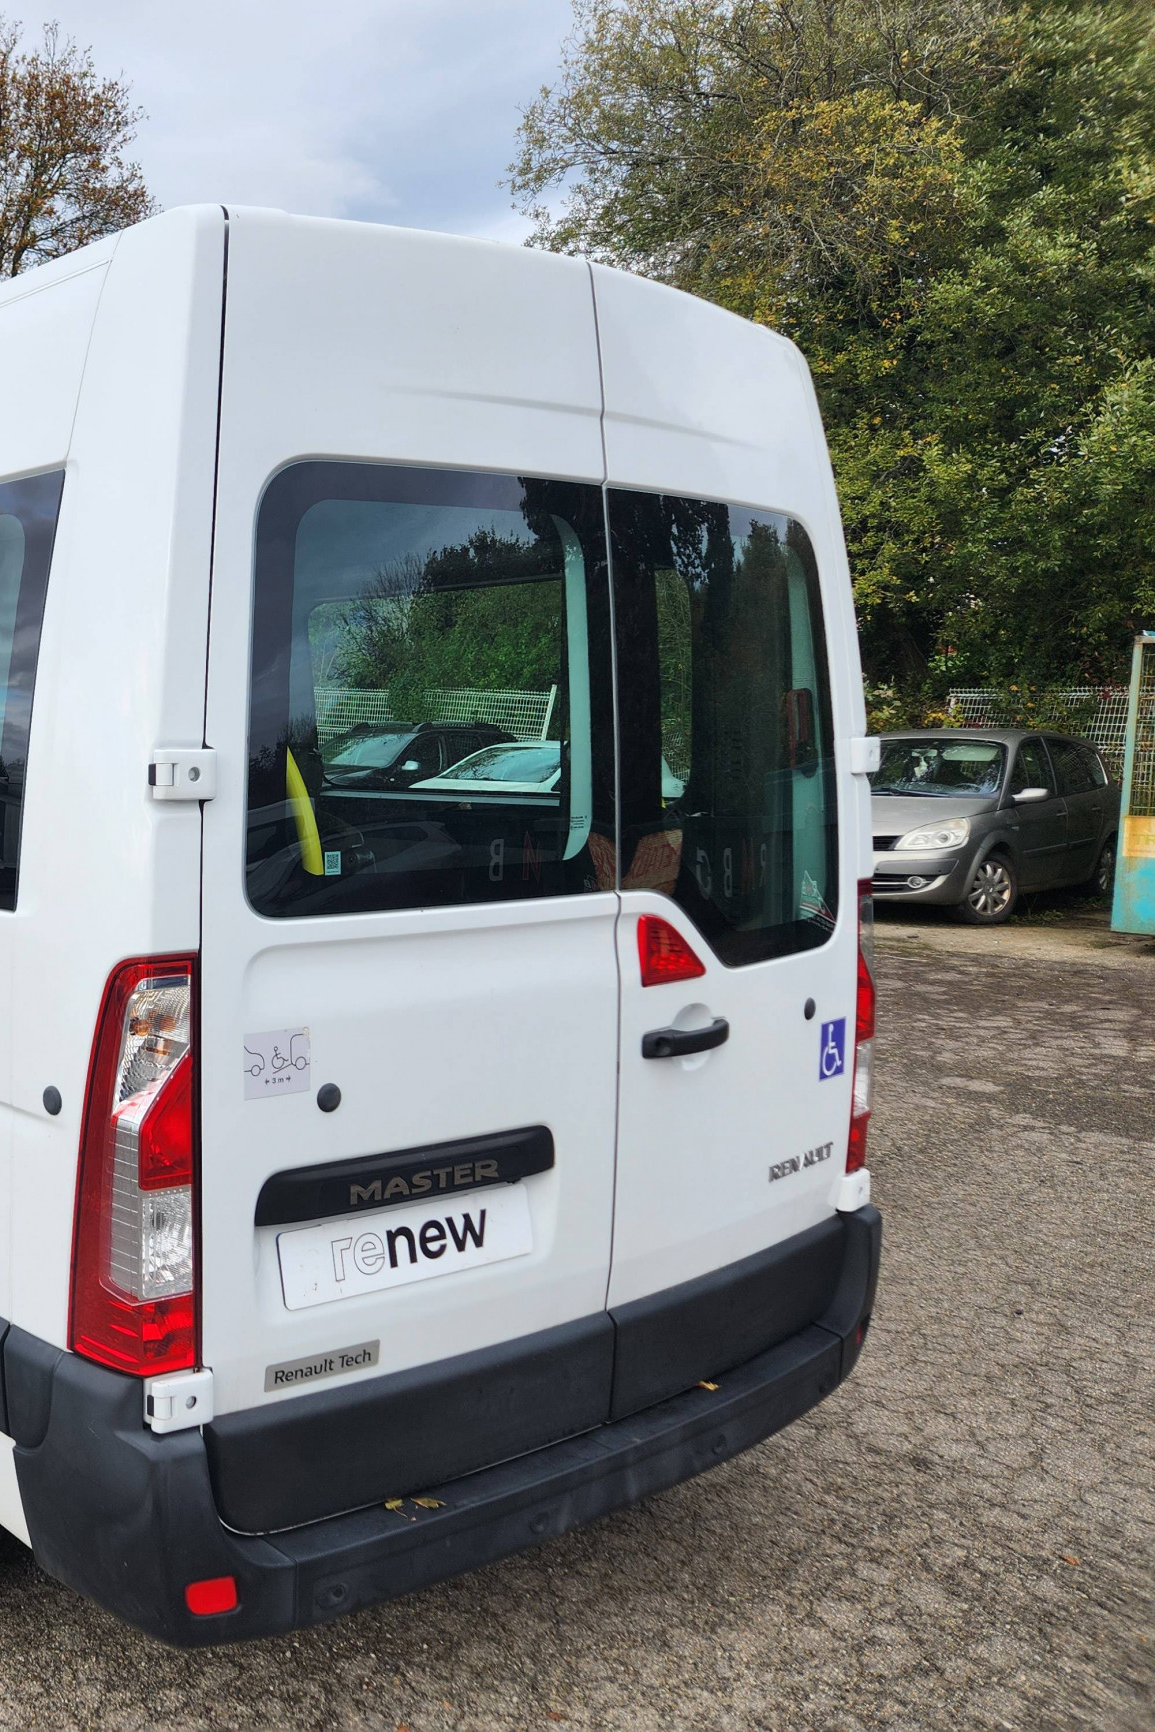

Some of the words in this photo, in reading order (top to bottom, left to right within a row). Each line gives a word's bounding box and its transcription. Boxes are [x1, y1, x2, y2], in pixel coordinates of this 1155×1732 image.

[271, 1077, 277, 1085] 3
[277, 1076, 285, 1084] m
[350, 1159, 499, 1205] MASTER
[768, 1141, 833, 1183] RENAULT
[331, 1208, 487, 1282] renew
[274, 1358, 334, 1384] Renault
[339, 1349, 372, 1368] Tech
